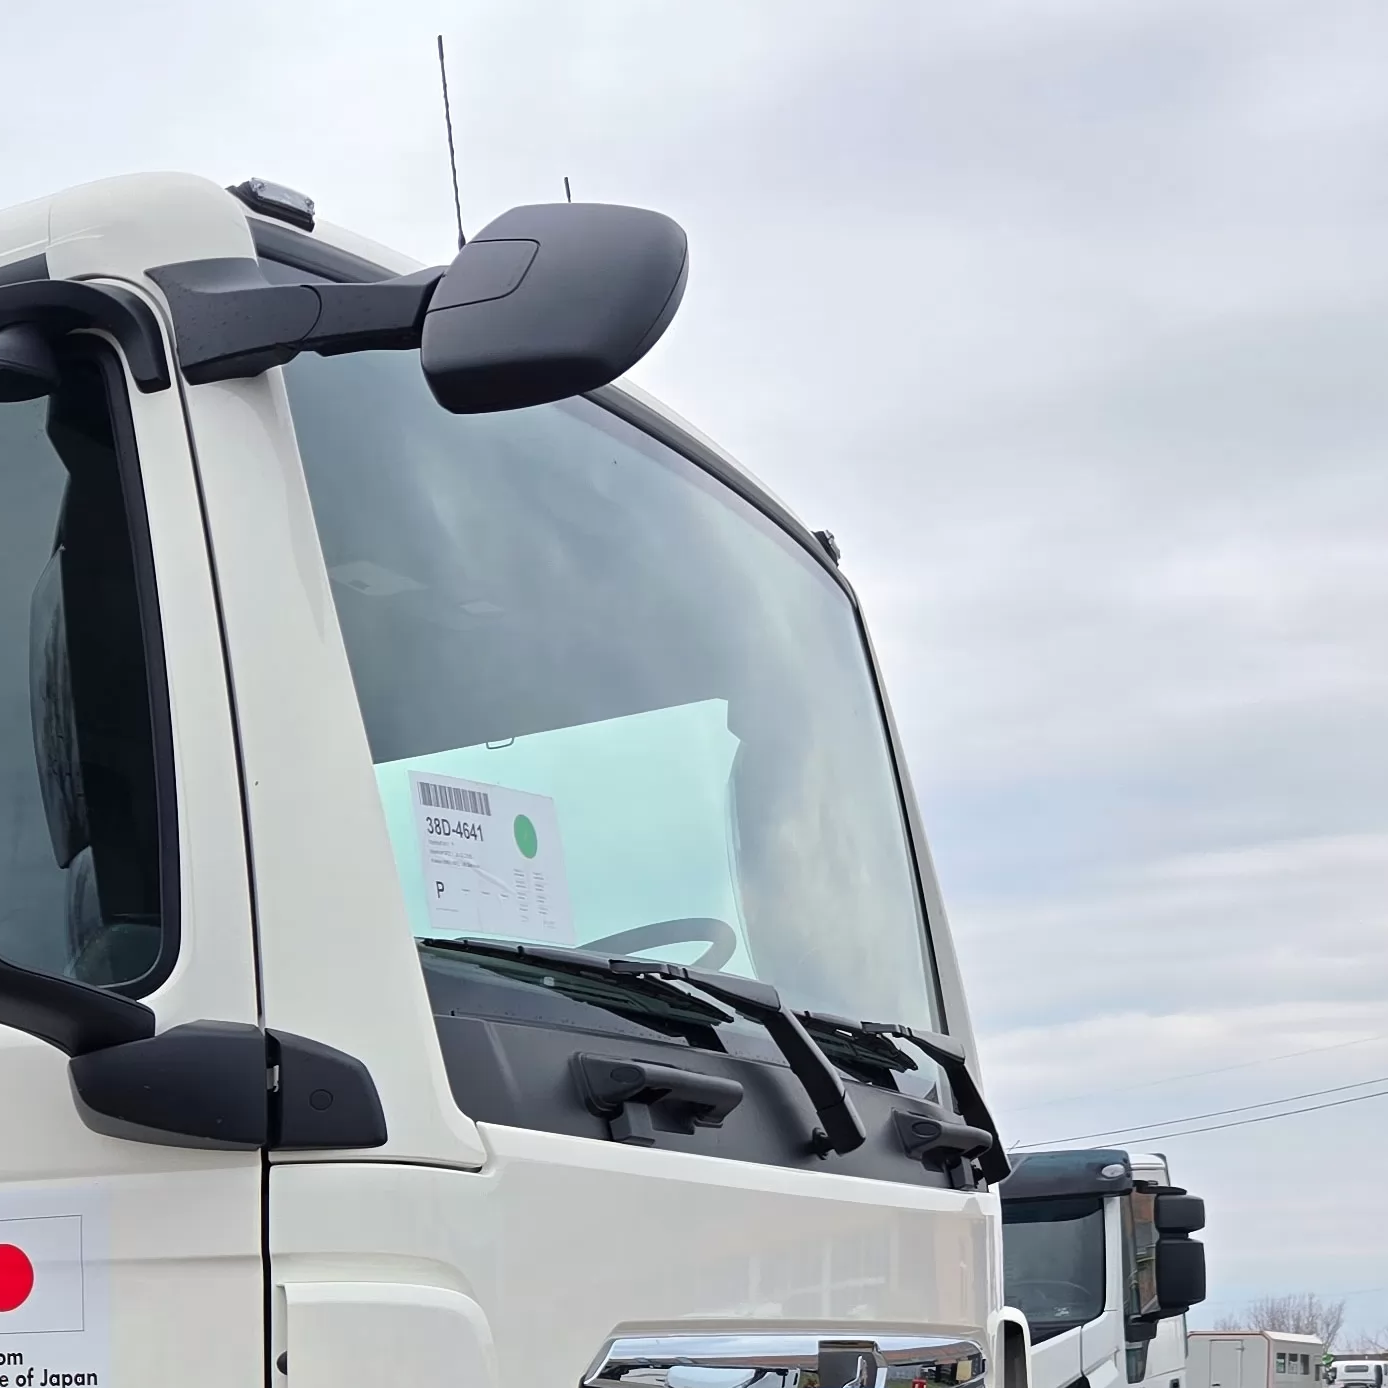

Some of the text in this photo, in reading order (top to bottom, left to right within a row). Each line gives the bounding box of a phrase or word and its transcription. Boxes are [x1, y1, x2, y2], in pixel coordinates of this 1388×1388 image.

[425, 817, 484, 842] 38D-4641
[436, 881, 445, 899] P
[15, 1367, 34, 1388] of
